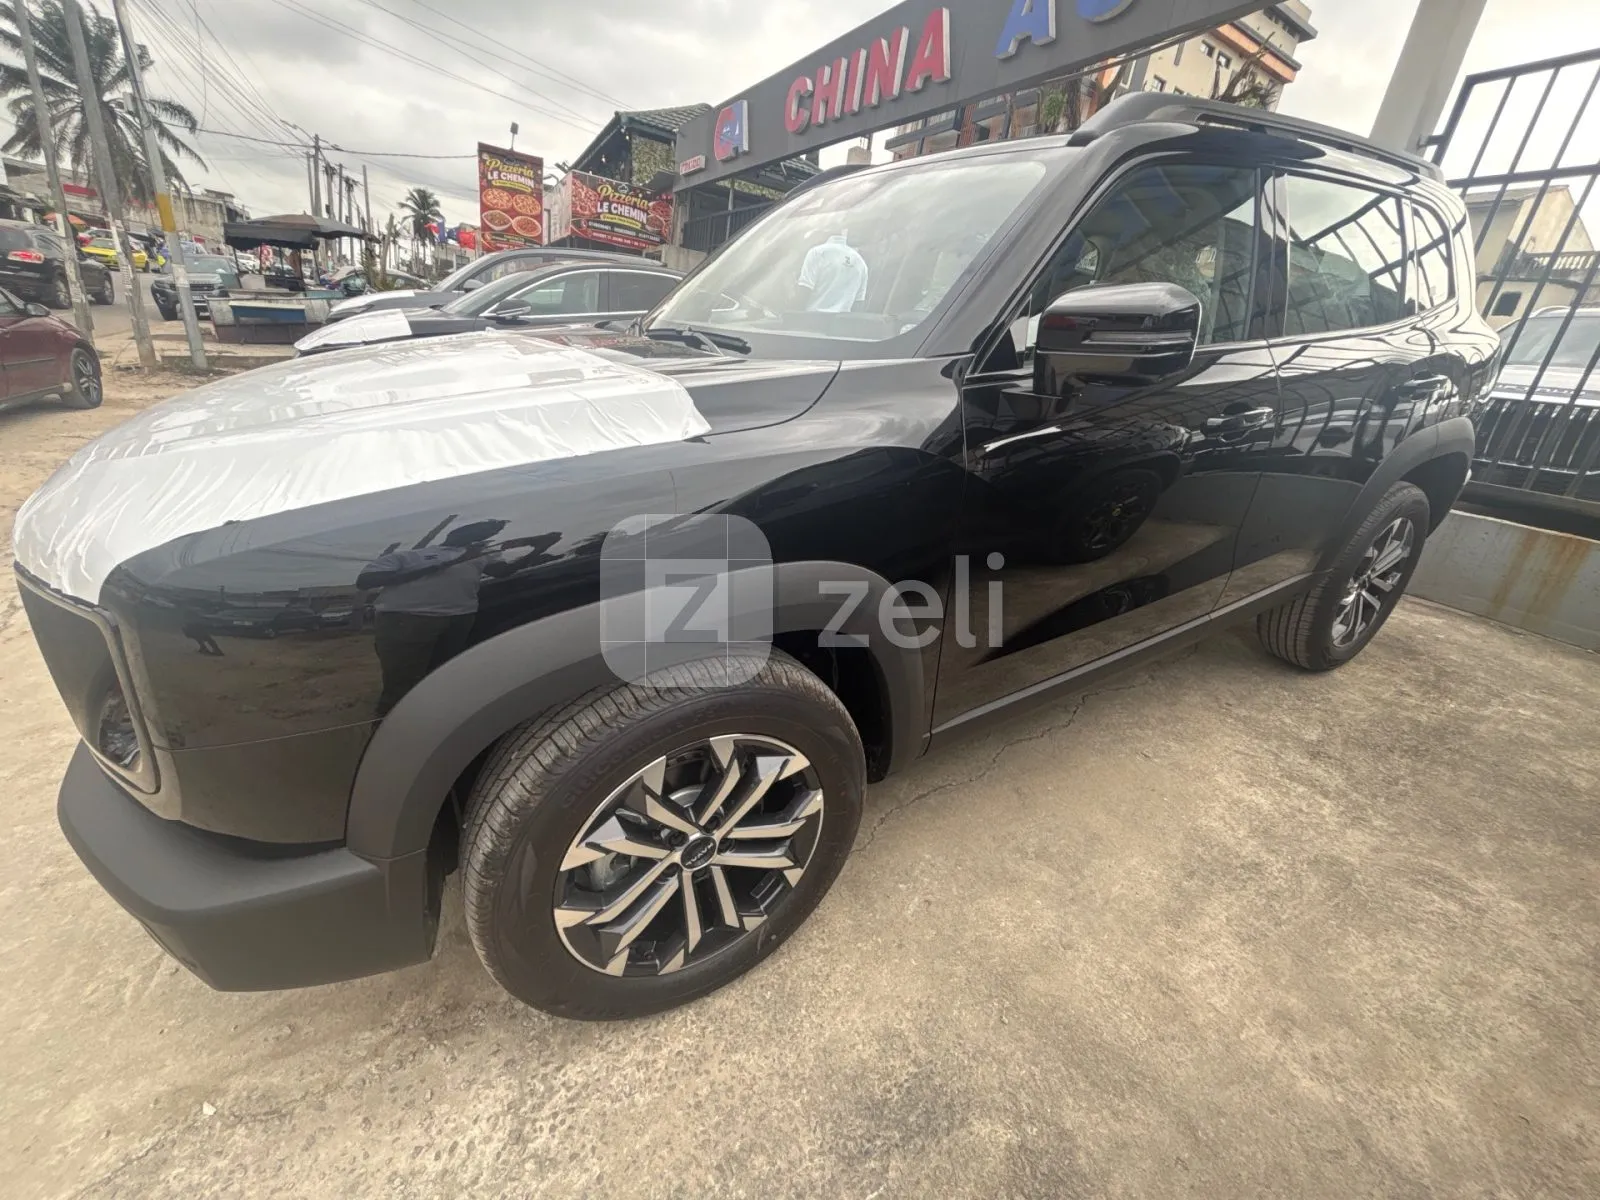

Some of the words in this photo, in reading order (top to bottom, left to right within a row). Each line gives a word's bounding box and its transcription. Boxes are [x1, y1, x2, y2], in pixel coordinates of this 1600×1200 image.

[784, 7, 951, 134] CHINA
[996, 0, 1137, 59] A
[487, 171, 499, 180] LE
[500, 172, 535, 189] CHEMIN
[597, 201, 609, 213] LE
[611, 203, 648, 225] CHEMIN
